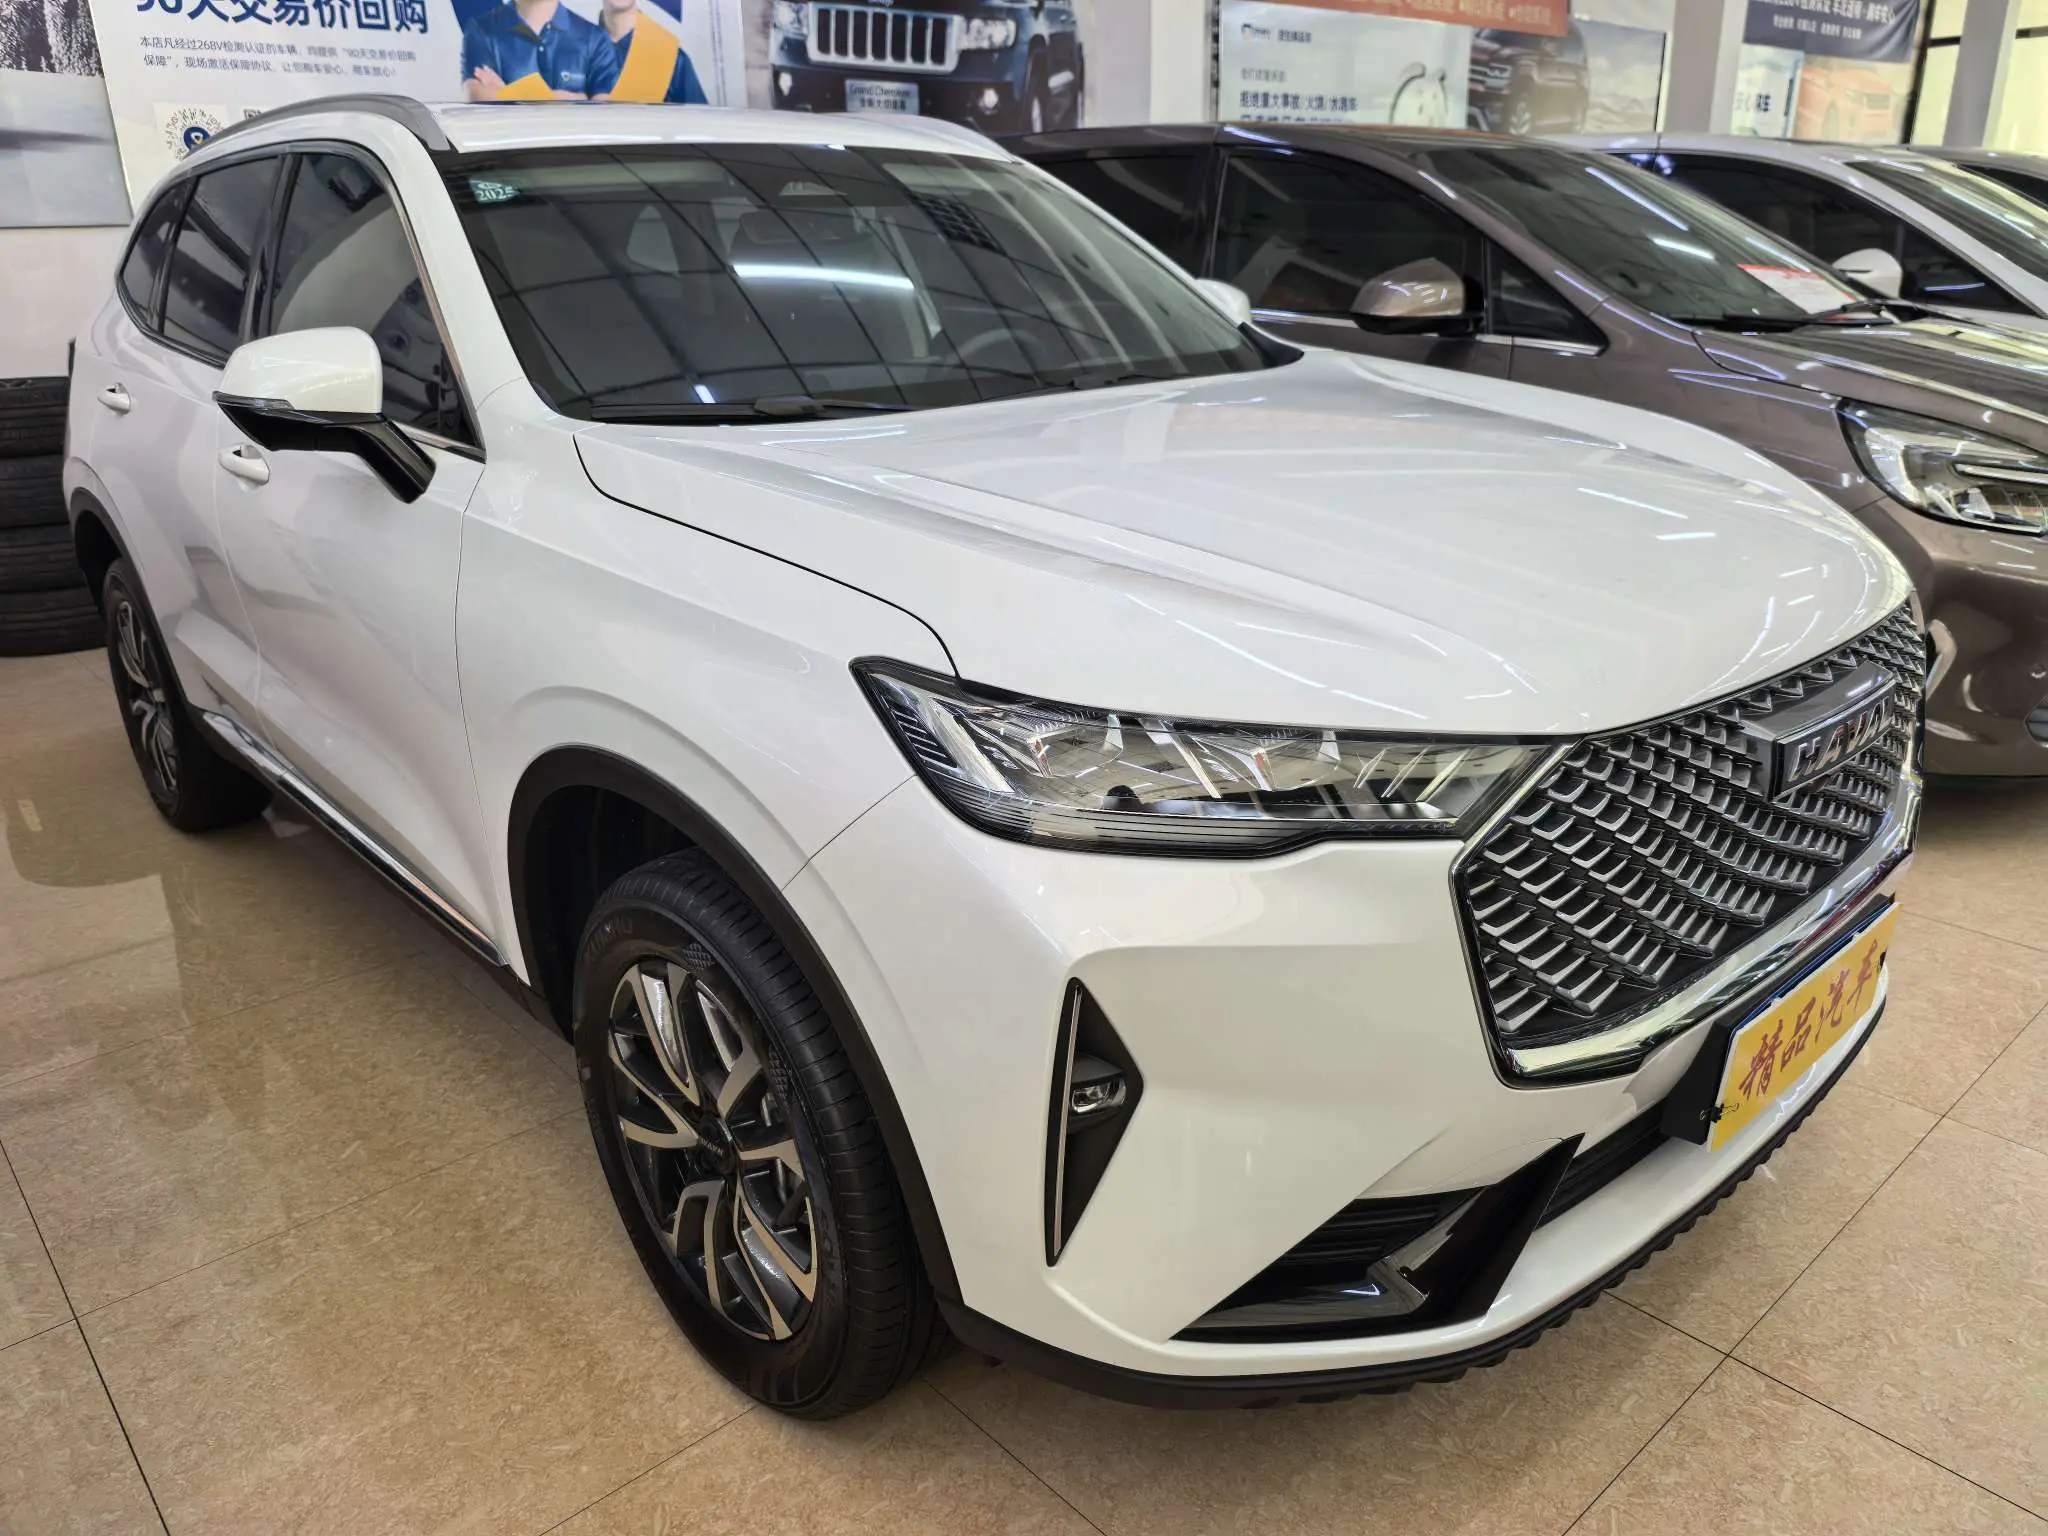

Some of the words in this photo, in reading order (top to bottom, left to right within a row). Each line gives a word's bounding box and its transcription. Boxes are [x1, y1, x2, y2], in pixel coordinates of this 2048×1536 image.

[1788, 695, 1893, 783] HAVAL
[1738, 938, 1878, 1101] 精品汽车
